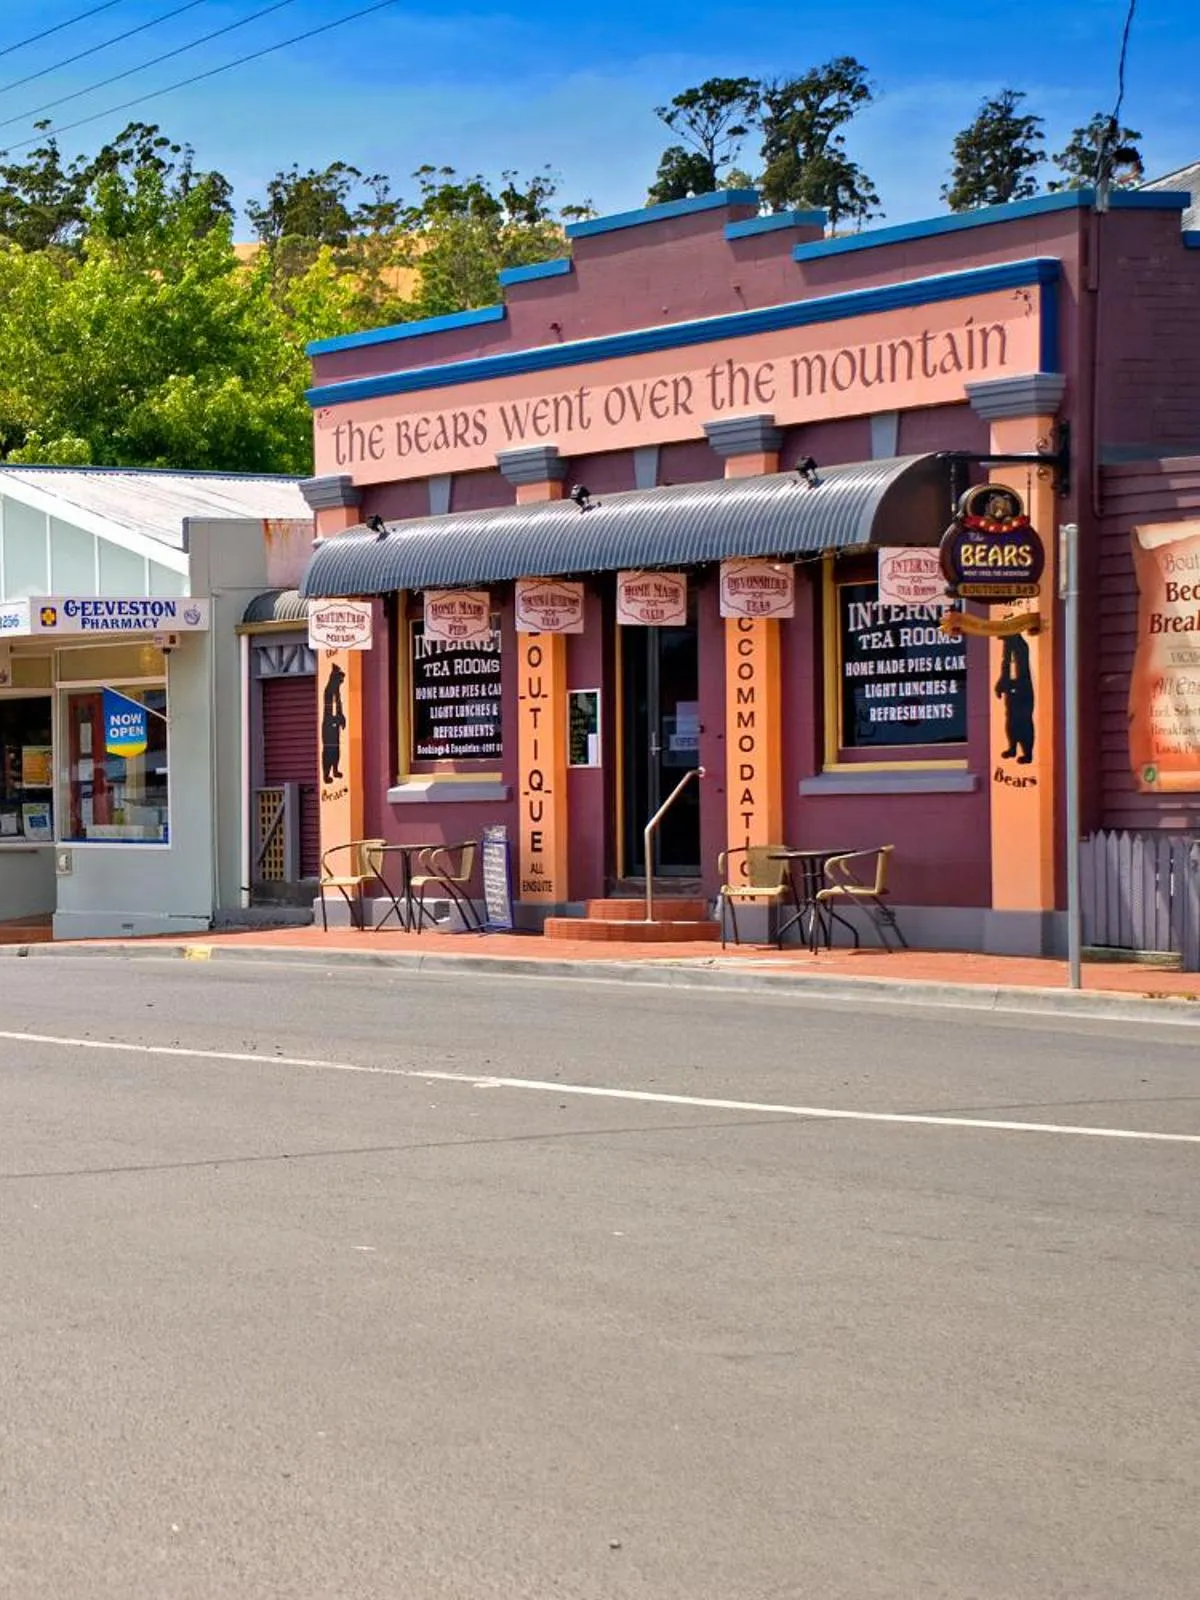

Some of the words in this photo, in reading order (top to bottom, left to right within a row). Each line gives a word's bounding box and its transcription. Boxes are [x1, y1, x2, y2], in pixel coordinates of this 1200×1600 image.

[396, 408, 488, 457] BEARS
[791, 316, 1007, 399] mountain
[961, 544, 1034, 567] BEARS
[891, 559, 940, 574] INTERNE
[64, 599, 177, 617] GEEVESTON
[847, 599, 966, 632] INTERN
[81, 617, 160, 630] PHARMACY
[858, 630, 896, 650] TEA
[423, 661, 450, 677] TEA
[453, 658, 500, 675] ROOMS
[845, 660, 875, 677] HOME
[876, 658, 905, 675] MADE
[907, 656, 932, 673] PIES
[934, 656, 942, 671] &
[415, 686, 438, 700] HOME
[438, 685, 460, 699] MADE
[461, 683, 480, 698] PIES
[480, 683, 487, 697] &
[864, 682, 897, 699] LIGHT
[898, 679, 947, 697] LUNCHES
[949, 679, 957, 694] &
[110, 712, 142, 726] NOW
[429, 705, 454, 719] LIGHT
[455, 703, 491, 718] LUNCHES
[492, 702, 499, 716] &
[869, 703, 954, 721] REFRESHMENTS
[109, 726, 145, 738] OPEN
[433, 723, 496, 739] REFRESHMENTS
[527, 631, 545, 853] OUTIQUE
[993, 766, 1038, 789] Bears
[530, 862, 544, 875] ALL
[522, 880, 553, 893] ENSUITE
